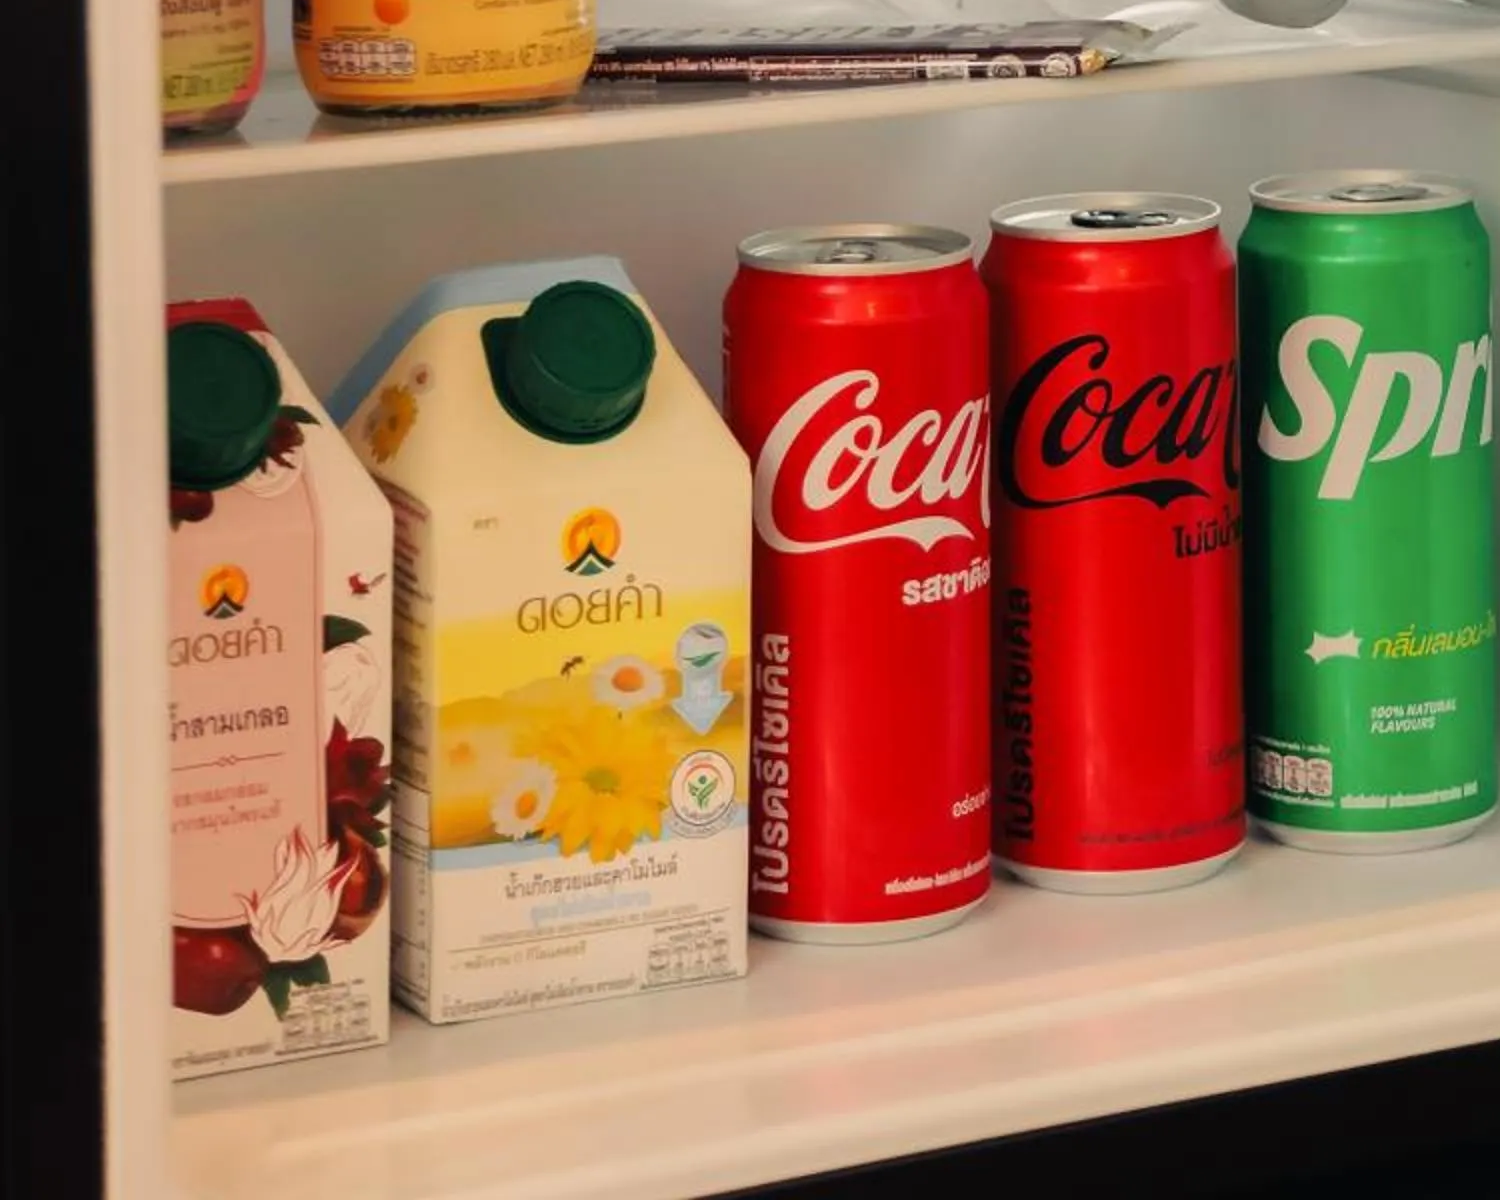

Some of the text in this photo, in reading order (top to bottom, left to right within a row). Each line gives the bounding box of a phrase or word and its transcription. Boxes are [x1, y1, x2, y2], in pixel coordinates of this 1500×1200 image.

[1001, 333, 1241, 510] Coca
[752, 368, 990, 554] Coca
[517, 573, 664, 635] ดอยคำ
[901, 555, 990, 607] รสชาติอ
[1370, 698, 1458, 720] 100% NATURAL
[1370, 715, 1437, 734] FLAVOURS
[752, 632, 791, 897] โปรดรีไซเคิล
